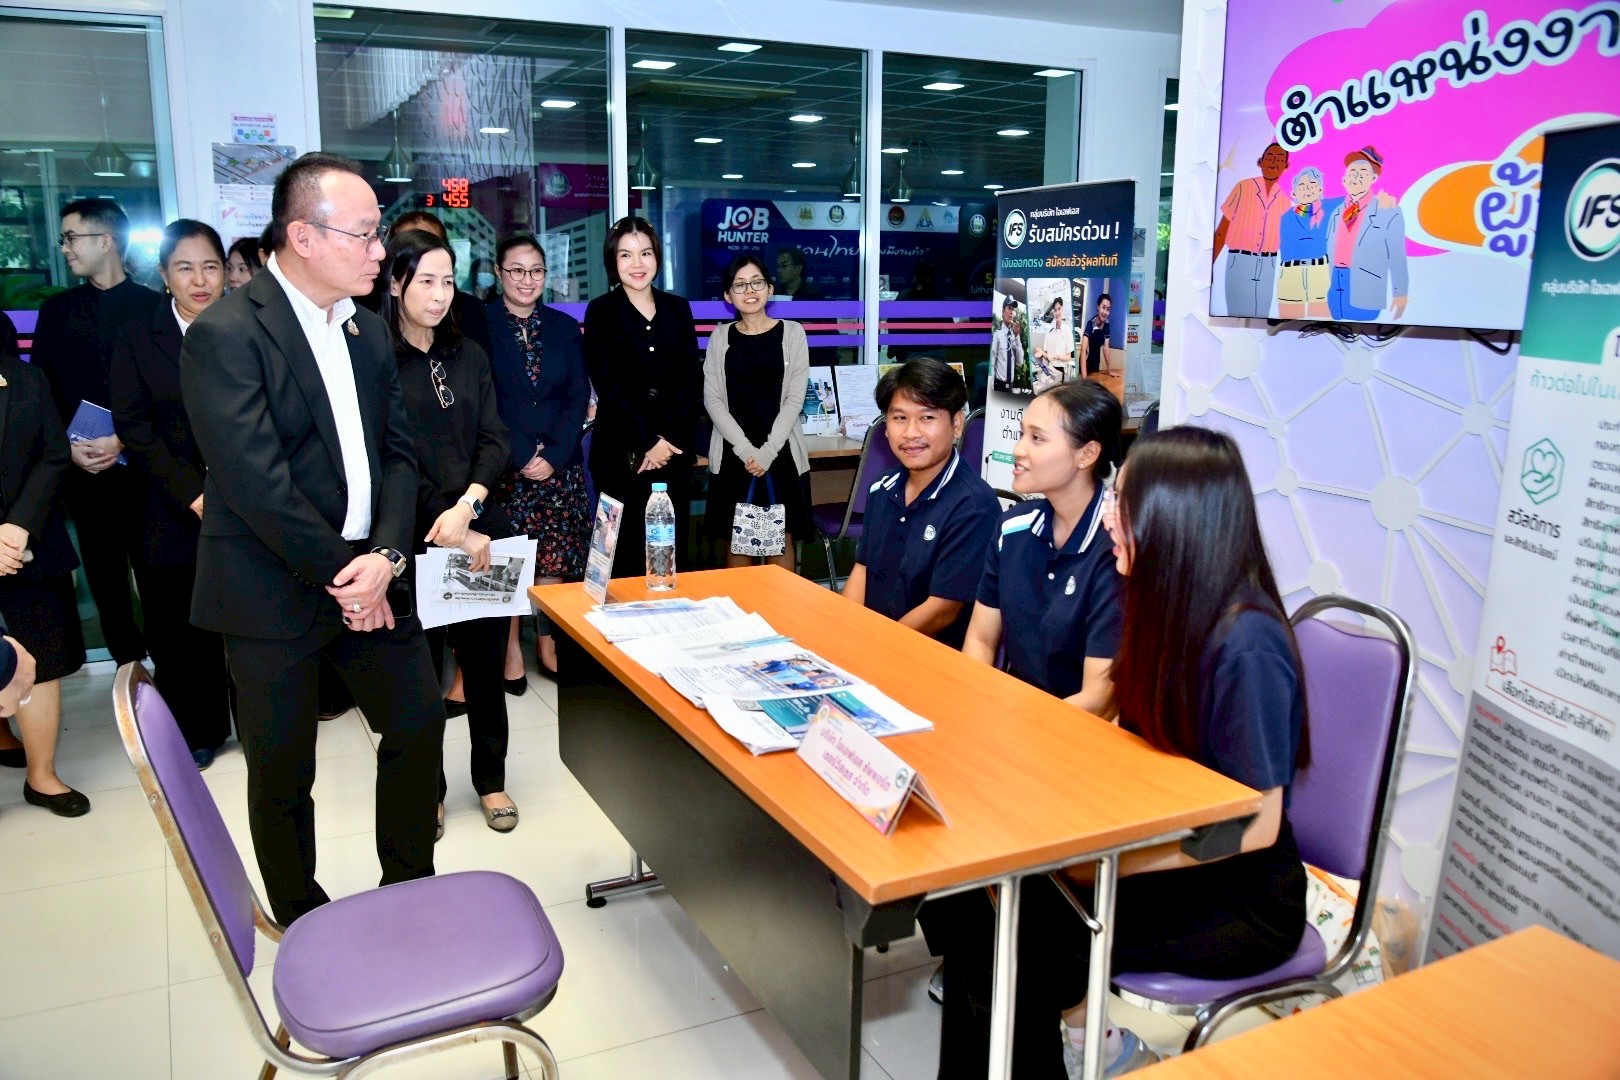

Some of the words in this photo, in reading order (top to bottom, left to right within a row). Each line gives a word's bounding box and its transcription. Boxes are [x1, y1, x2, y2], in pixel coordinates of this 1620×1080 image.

[441, 178, 469, 193] 458
[426, 194, 434, 207] 3
[442, 193, 469, 208] 455
[1480, 160, 1539, 258] ผู้
[717, 206, 770, 230] JOB
[717, 231, 770, 244] HUNTER
[1008, 222, 1024, 237] IFS
[1028, 220, 1111, 243] รับสมัครด่วน
[1114, 221, 1120, 240] !
[1045, 253, 1118, 271] สมัครแล้วรู้ผลทันที
[1507, 508, 1561, 539] สวัสดิการ
